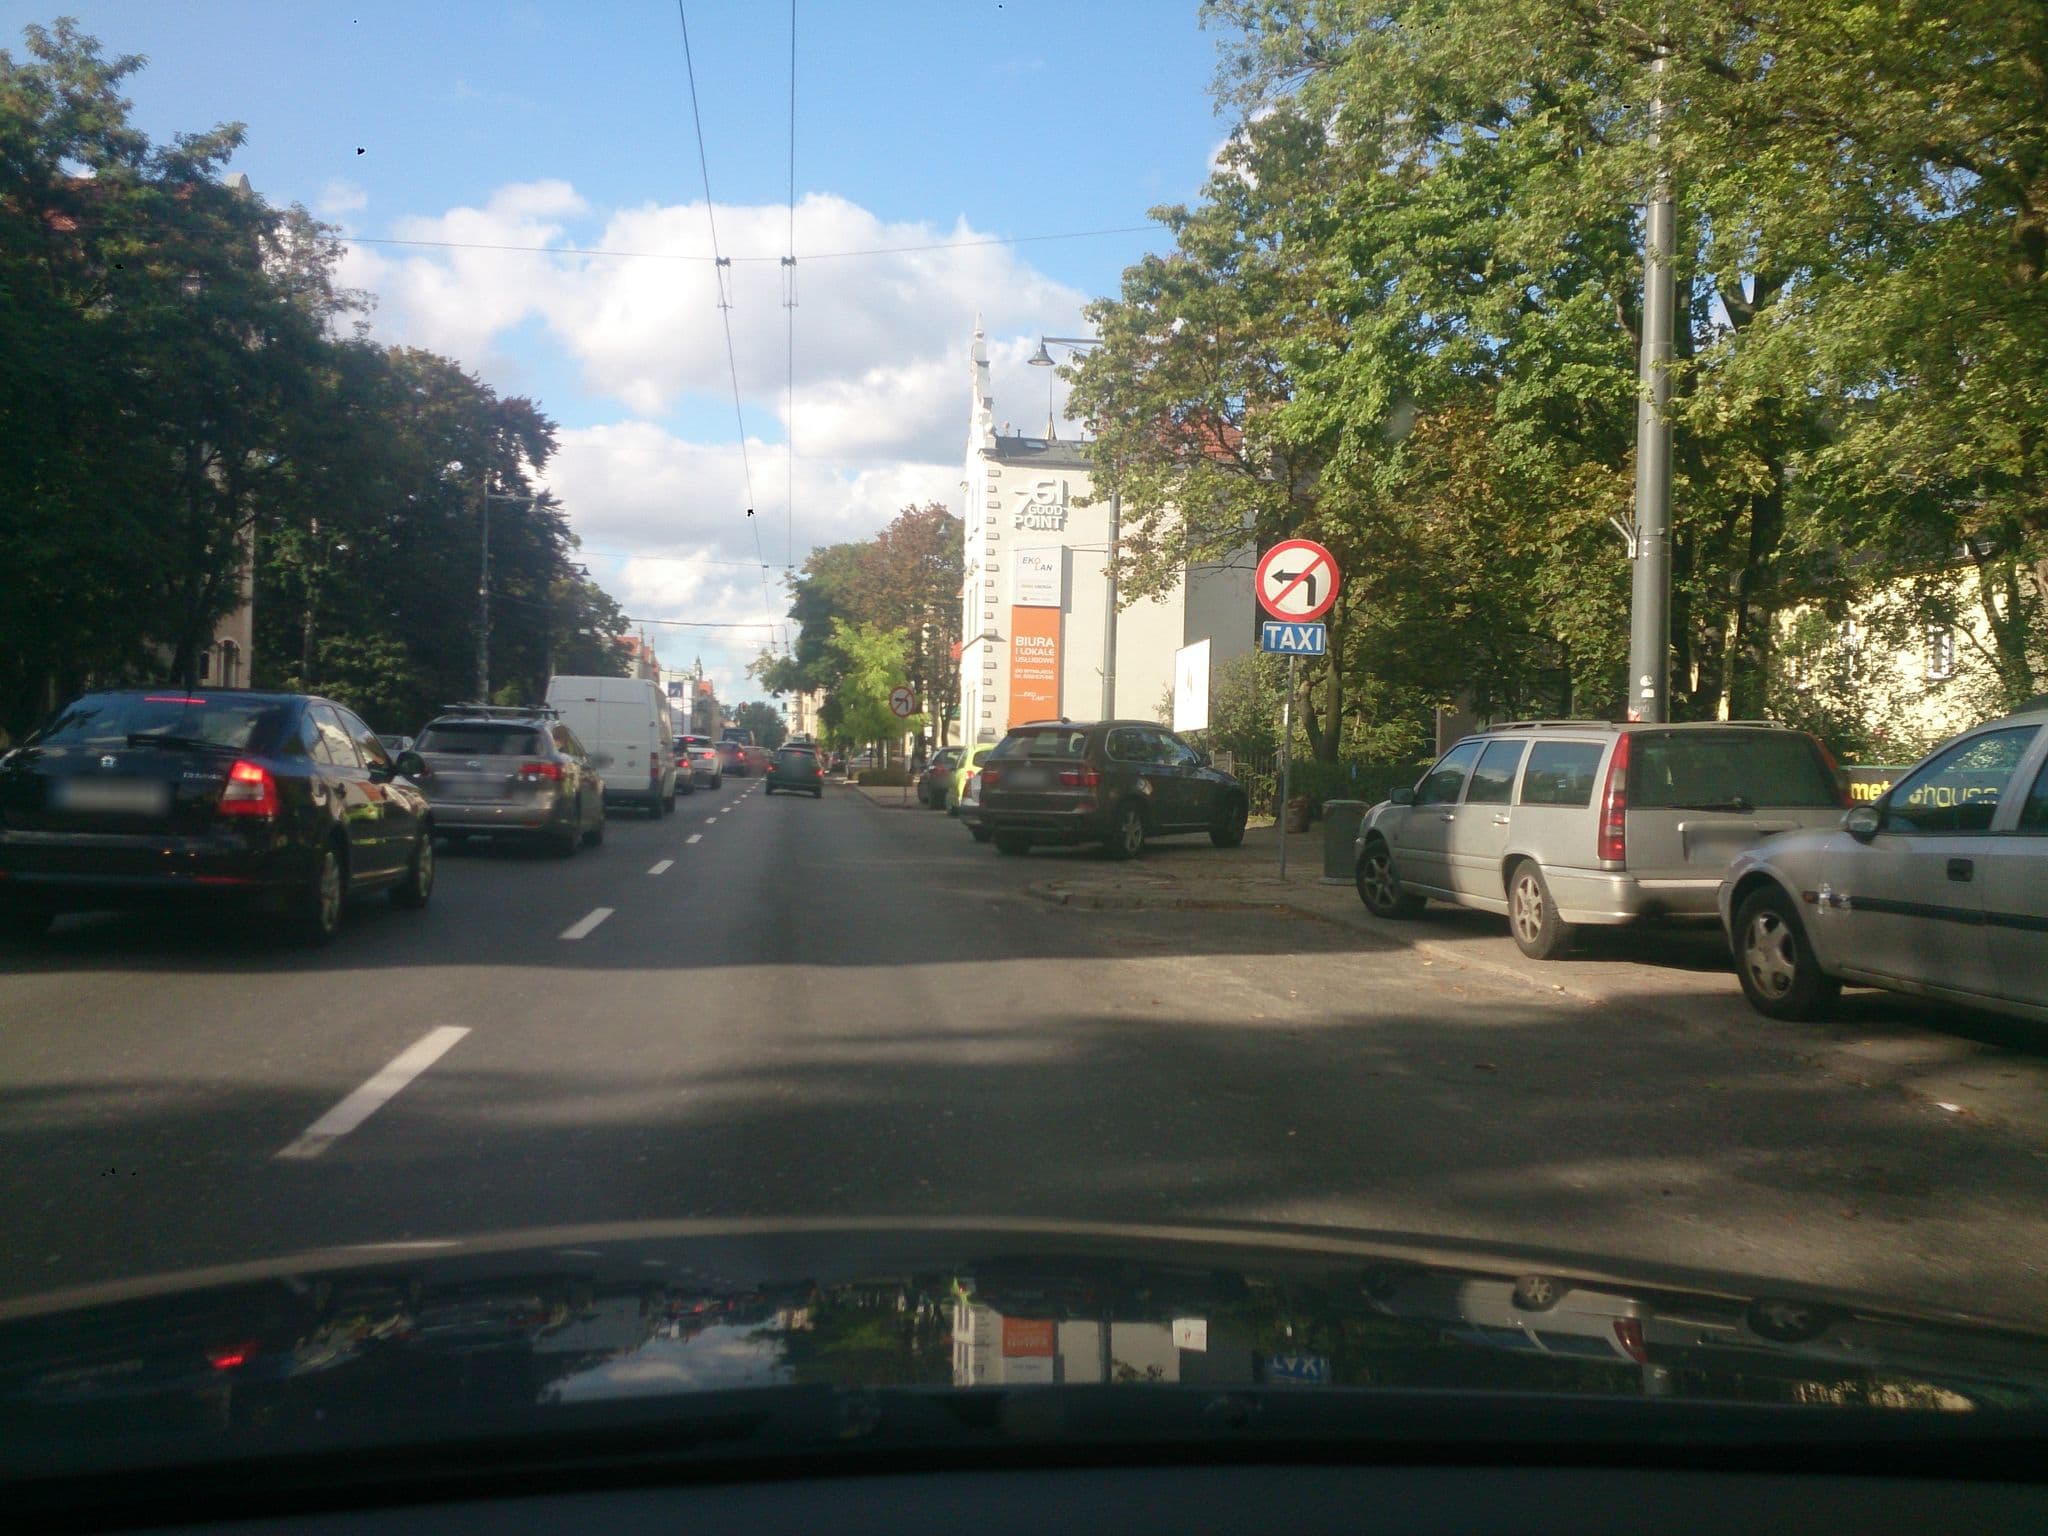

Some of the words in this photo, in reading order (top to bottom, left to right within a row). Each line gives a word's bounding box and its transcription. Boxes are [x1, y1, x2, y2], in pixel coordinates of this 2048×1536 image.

[1029, 505, 1063, 515] GOOD
[1014, 515, 1063, 529] POINT
[1015, 636, 1055, 647] BIURA
[1265, 625, 1322, 651] TAXI
[1020, 647, 1055, 656] LOKALE
